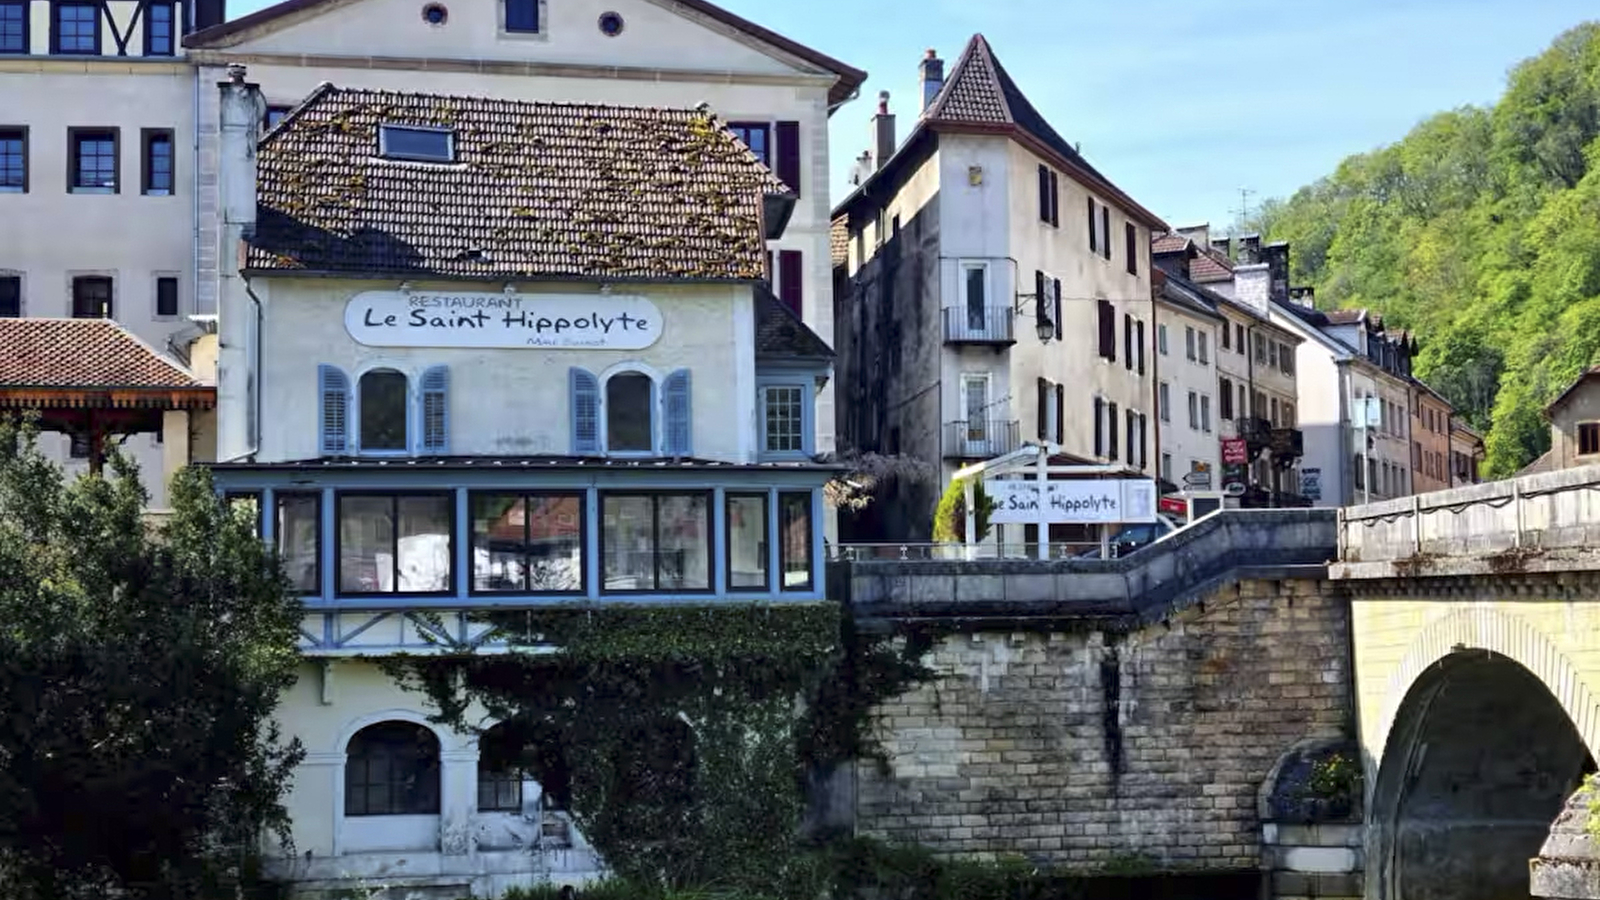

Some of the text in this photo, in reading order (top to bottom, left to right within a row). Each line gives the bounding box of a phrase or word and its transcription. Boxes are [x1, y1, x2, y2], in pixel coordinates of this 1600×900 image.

[408, 296, 523, 309] RESTAURANT
[364, 308, 648, 333] Le Saint Hippolyte
[1009, 494, 1039, 511] Sain
[1050, 495, 1116, 514] Hippolyte
